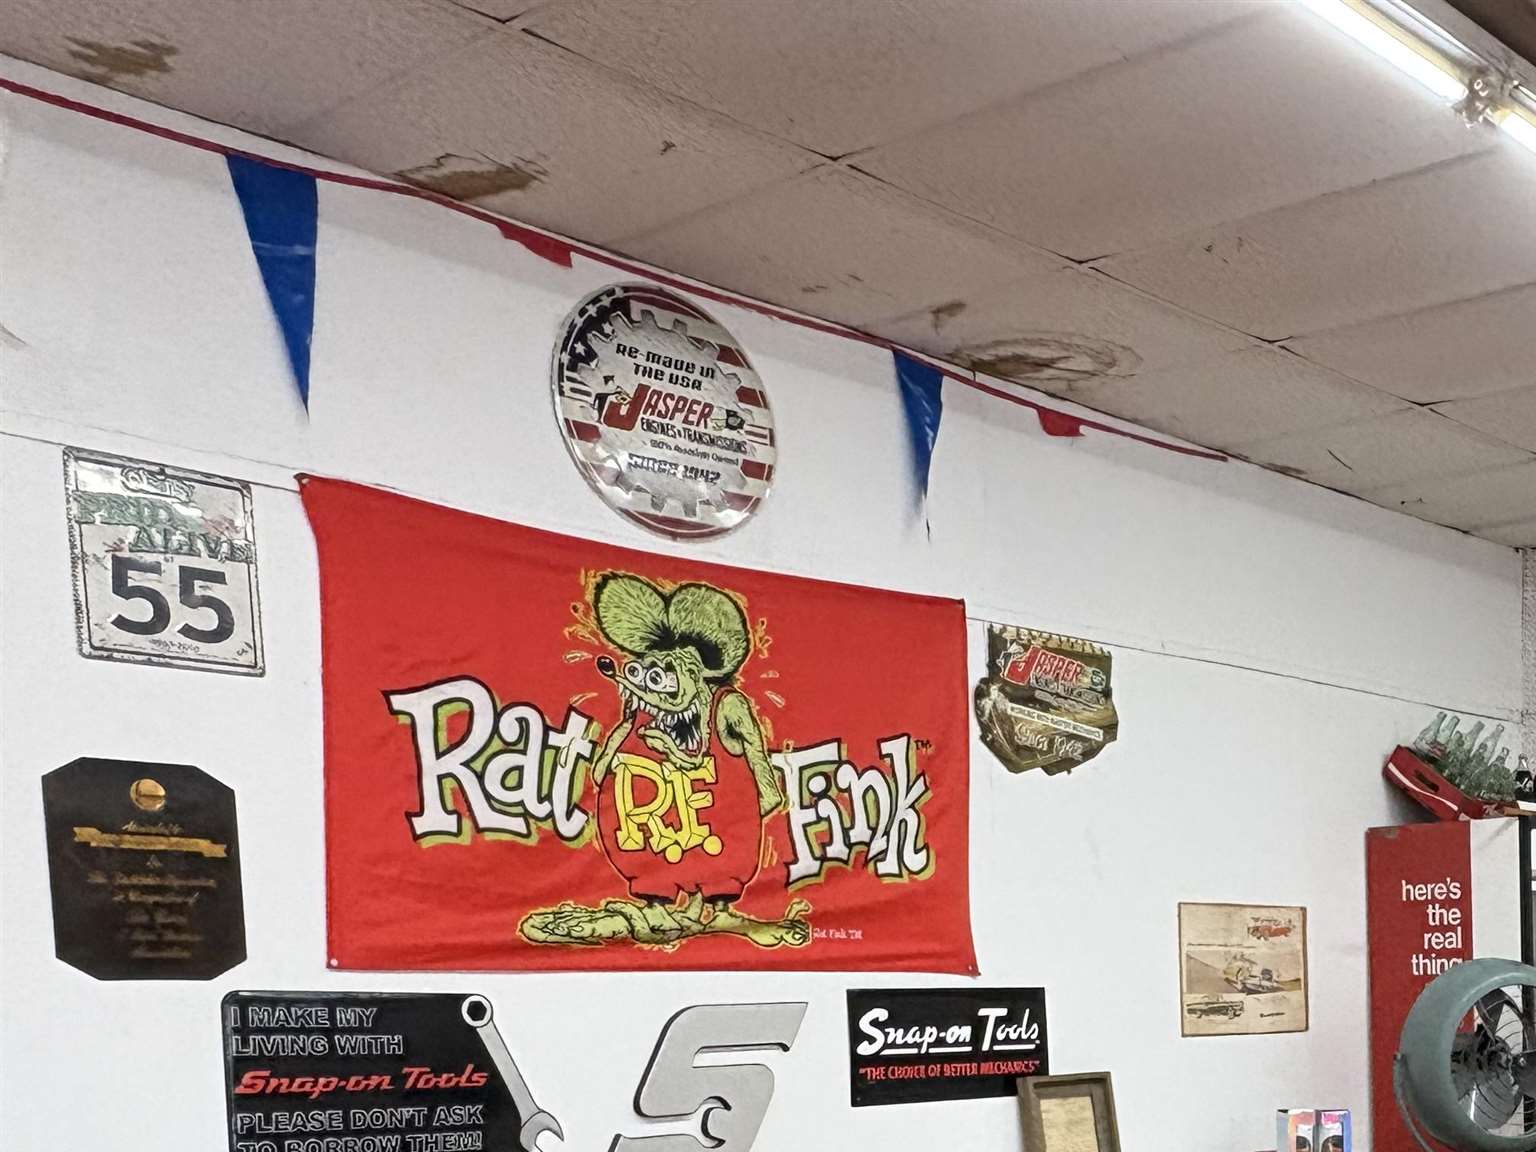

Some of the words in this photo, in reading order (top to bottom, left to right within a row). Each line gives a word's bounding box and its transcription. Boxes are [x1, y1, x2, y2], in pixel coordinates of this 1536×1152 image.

[602, 384, 714, 431] JASPER
[110, 554, 235, 643] 55
[1004, 645, 1085, 686] JASPER
[383, 676, 598, 843] Rat
[770, 734, 934, 888] Fink
[1401, 878, 1462, 902] here's
[1427, 904, 1462, 926] the
[1424, 928, 1462, 949] real
[231, 1007, 240, 1027] I
[250, 1007, 329, 1027] MAKE
[337, 1007, 377, 1027] MY
[856, 1008, 973, 1055] Snap-on
[977, 1007, 1041, 1051] Tools
[232, 1036, 329, 1056] LIVING
[335, 1035, 403, 1055] WITH
[234, 1069, 395, 1099] Snap-on
[402, 1063, 488, 1089] Tools
[928, 1064, 941, 1076] OF
[237, 1110, 343, 1134] PLEASE
[351, 1108, 427, 1129] DON'T
[433, 1105, 483, 1125] ASK
[406, 1131, 483, 1152] THEM!
